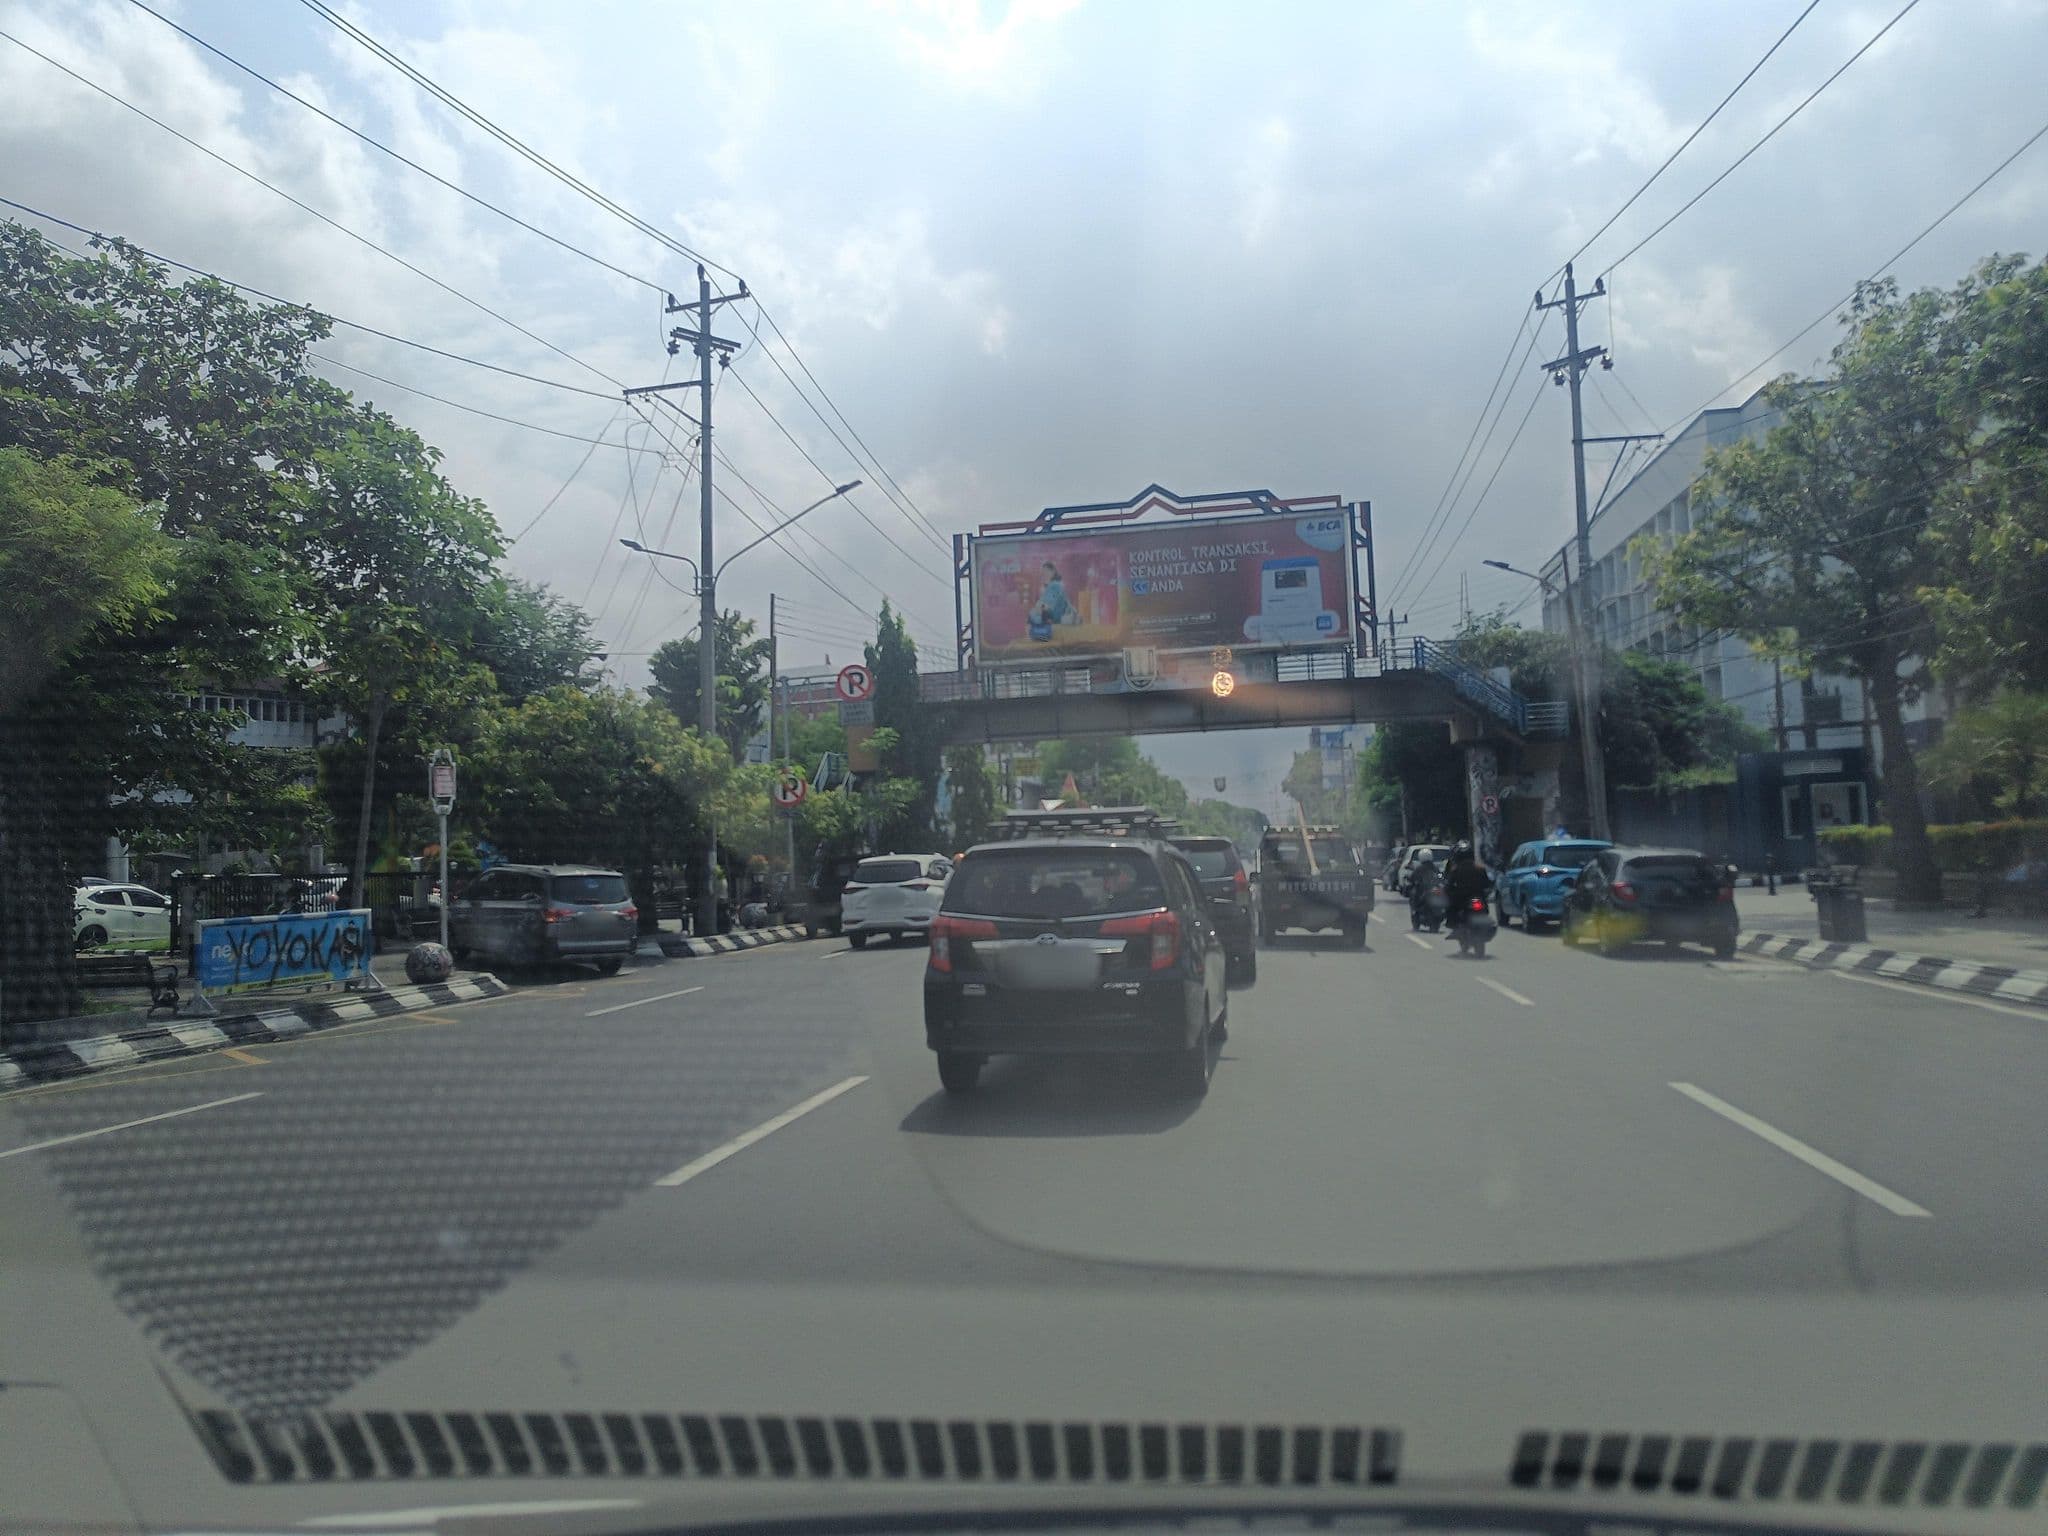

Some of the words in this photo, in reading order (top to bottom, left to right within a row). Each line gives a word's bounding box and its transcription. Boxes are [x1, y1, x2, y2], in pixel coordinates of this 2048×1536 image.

[1129, 548, 1185, 563] KONTROL
[1130, 560, 1215, 578] SENANTIASA
[1220, 558, 1237, 573] DI
[1151, 579, 1184, 593] ANDA
[848, 671, 864, 695] P
